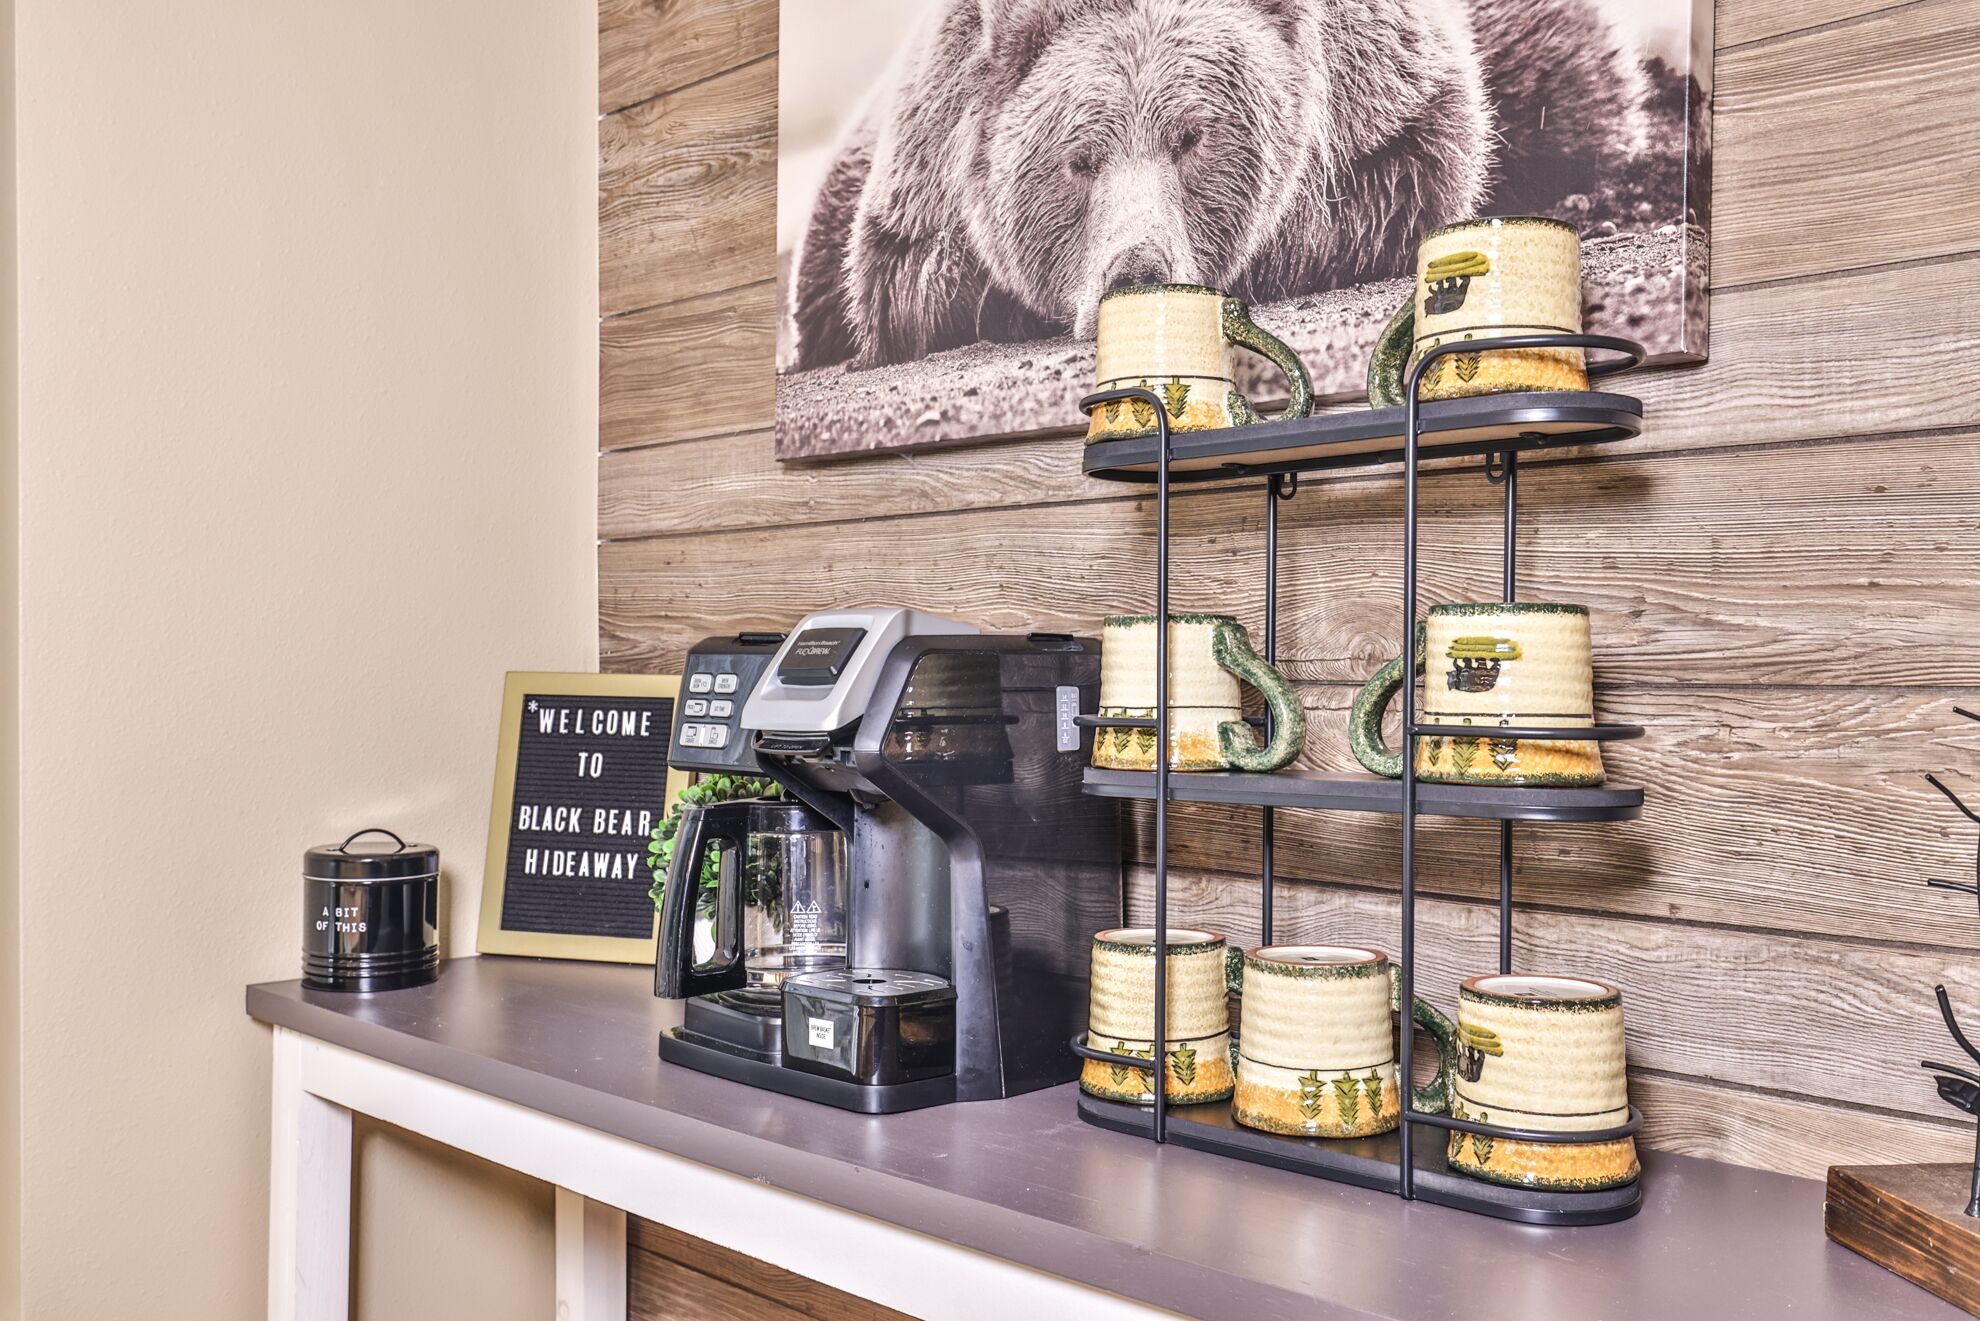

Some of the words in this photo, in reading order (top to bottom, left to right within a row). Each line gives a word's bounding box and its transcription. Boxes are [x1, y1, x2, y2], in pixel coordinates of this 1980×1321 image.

[539, 708, 652, 737] WELCOME
[578, 752, 604, 779] TO
[518, 805, 582, 834] BLACK
[593, 809, 651, 837] BEAR
[524, 849, 640, 880] HIDEAWAY
[322, 906, 329, 917] A
[335, 907, 359, 918] BIT
[316, 921, 329, 931] OF
[335, 922, 367, 933] THIS
